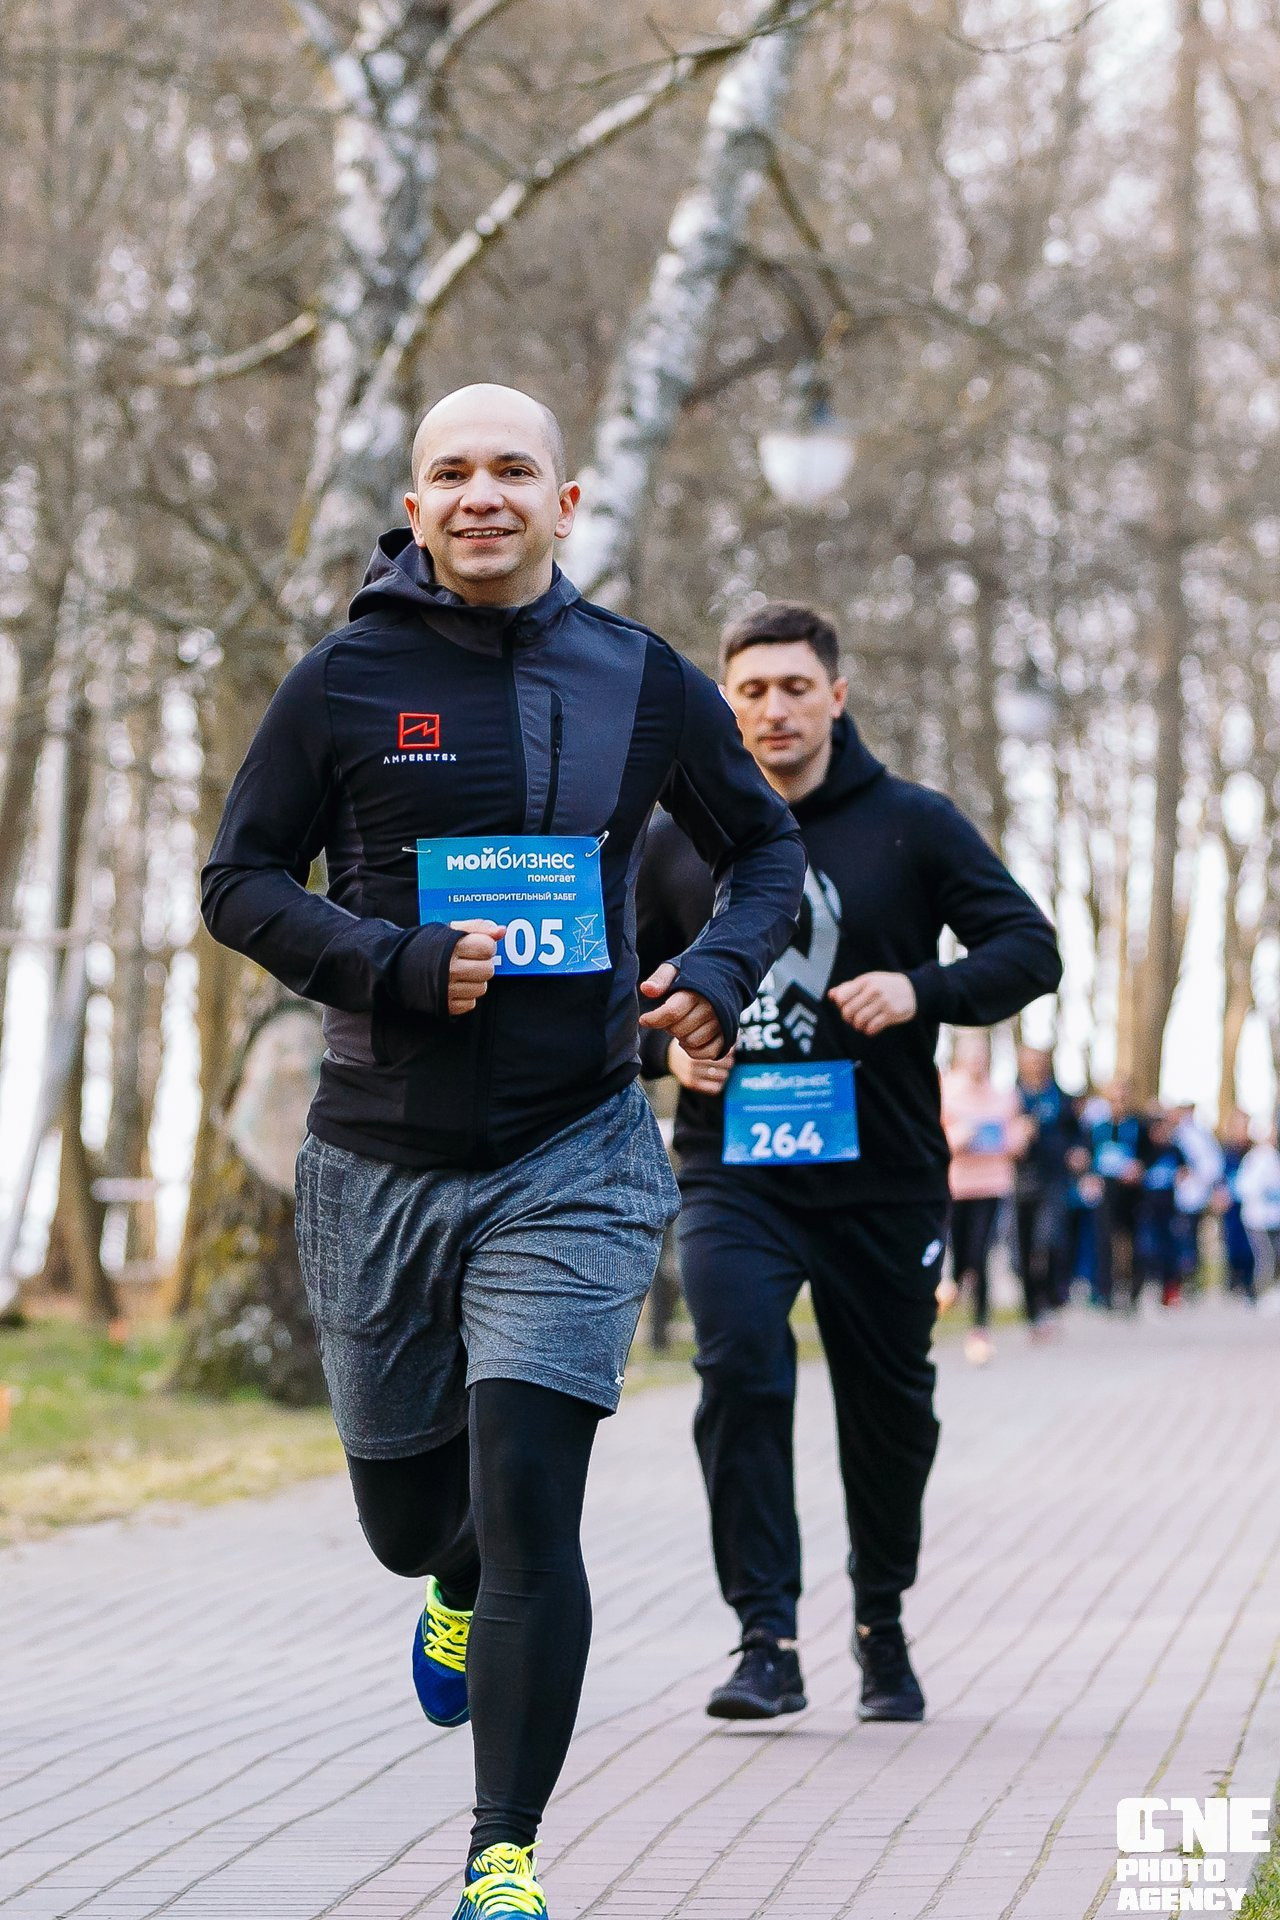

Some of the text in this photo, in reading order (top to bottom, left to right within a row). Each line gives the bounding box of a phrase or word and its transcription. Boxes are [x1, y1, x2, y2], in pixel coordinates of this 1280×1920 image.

[527, 874, 576, 883] помогает
[453, 892, 551, 903] БЛАГОТВОРИТЕЛЬНЫЙ
[553, 893, 576, 901] ЗАБЕГ
[493, 918, 565, 966] 05
[750, 1121, 823, 1158] 264
